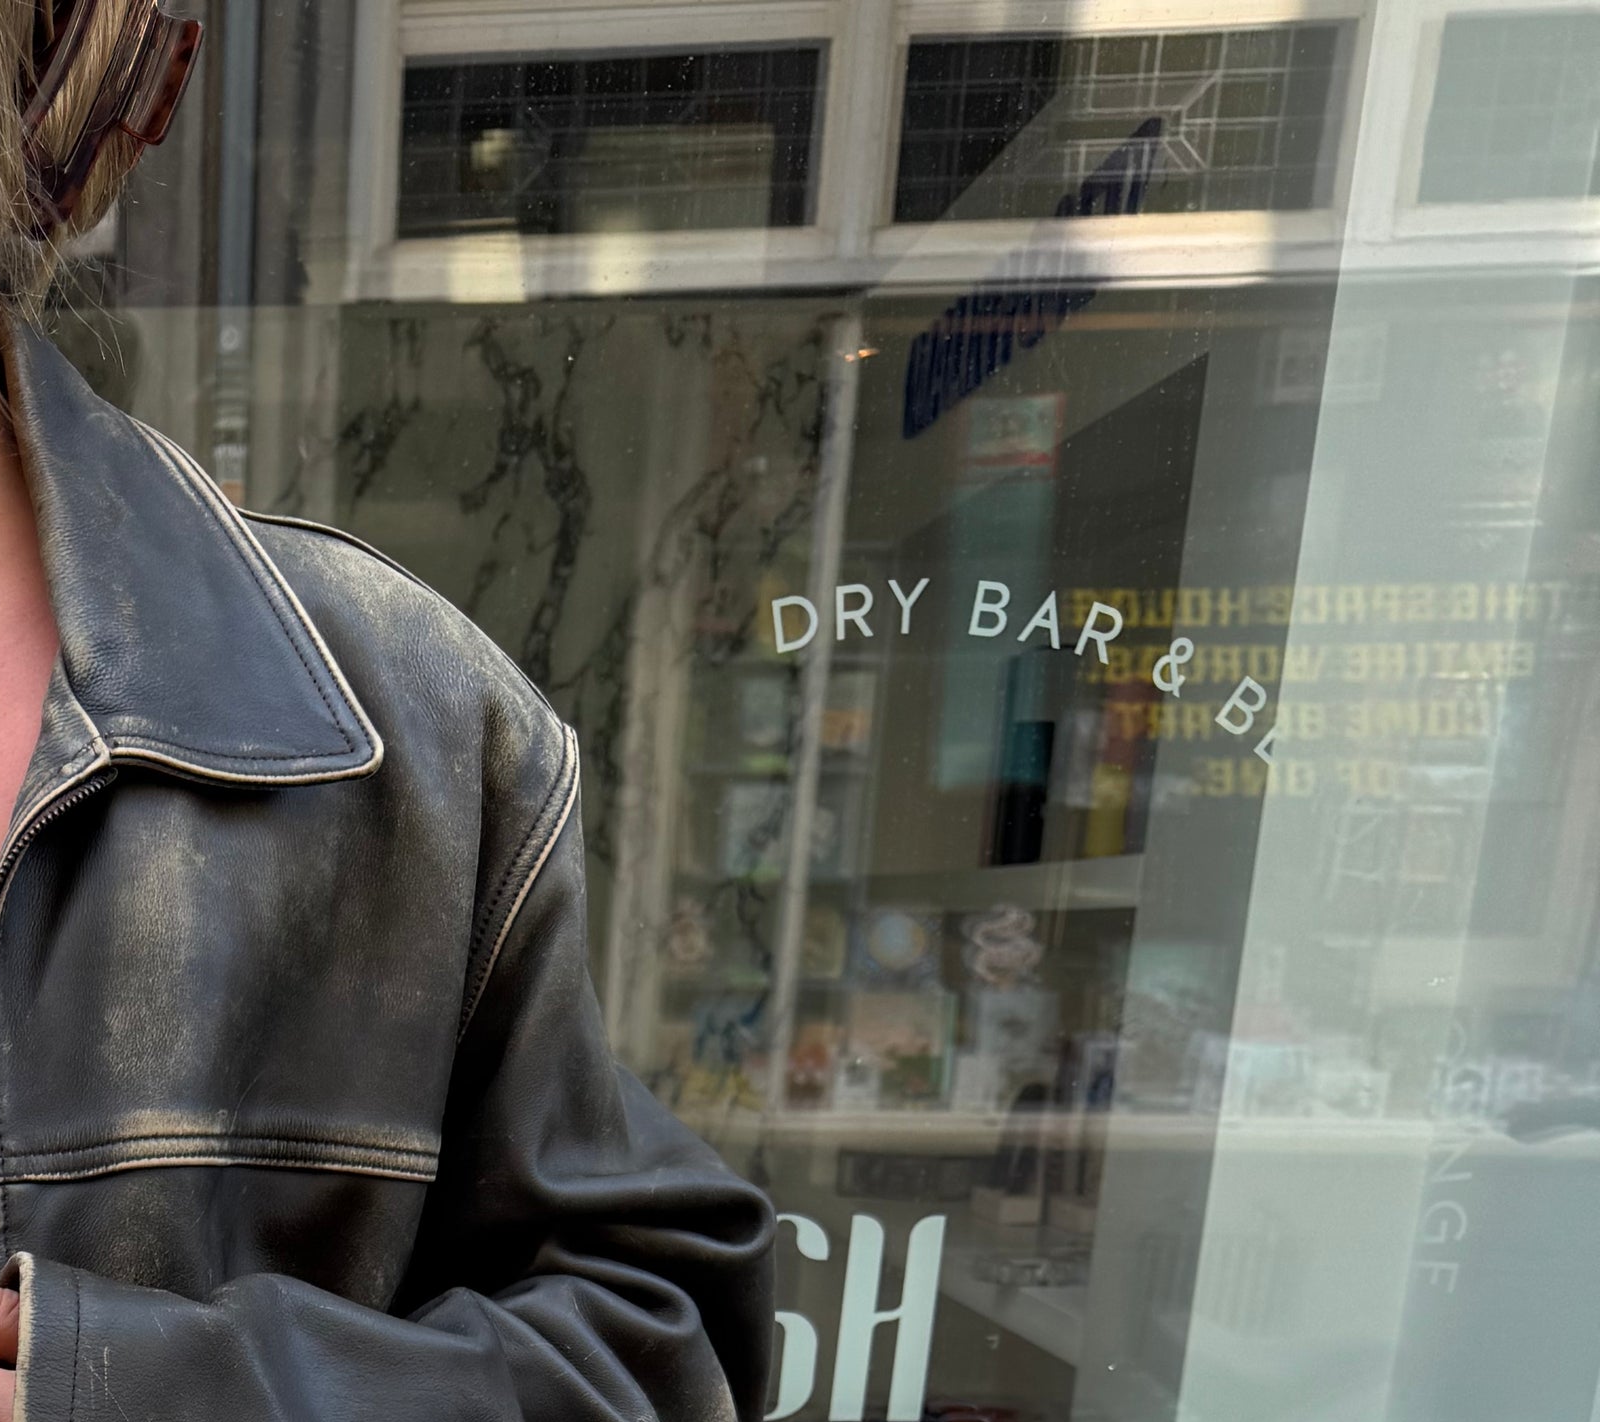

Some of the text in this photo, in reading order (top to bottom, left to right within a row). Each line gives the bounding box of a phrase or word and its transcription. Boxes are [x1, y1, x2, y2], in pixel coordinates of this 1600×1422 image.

[771, 577, 930, 654] DRY
[968, 580, 1123, 665] BAR
[1152, 637, 1195, 698] &
